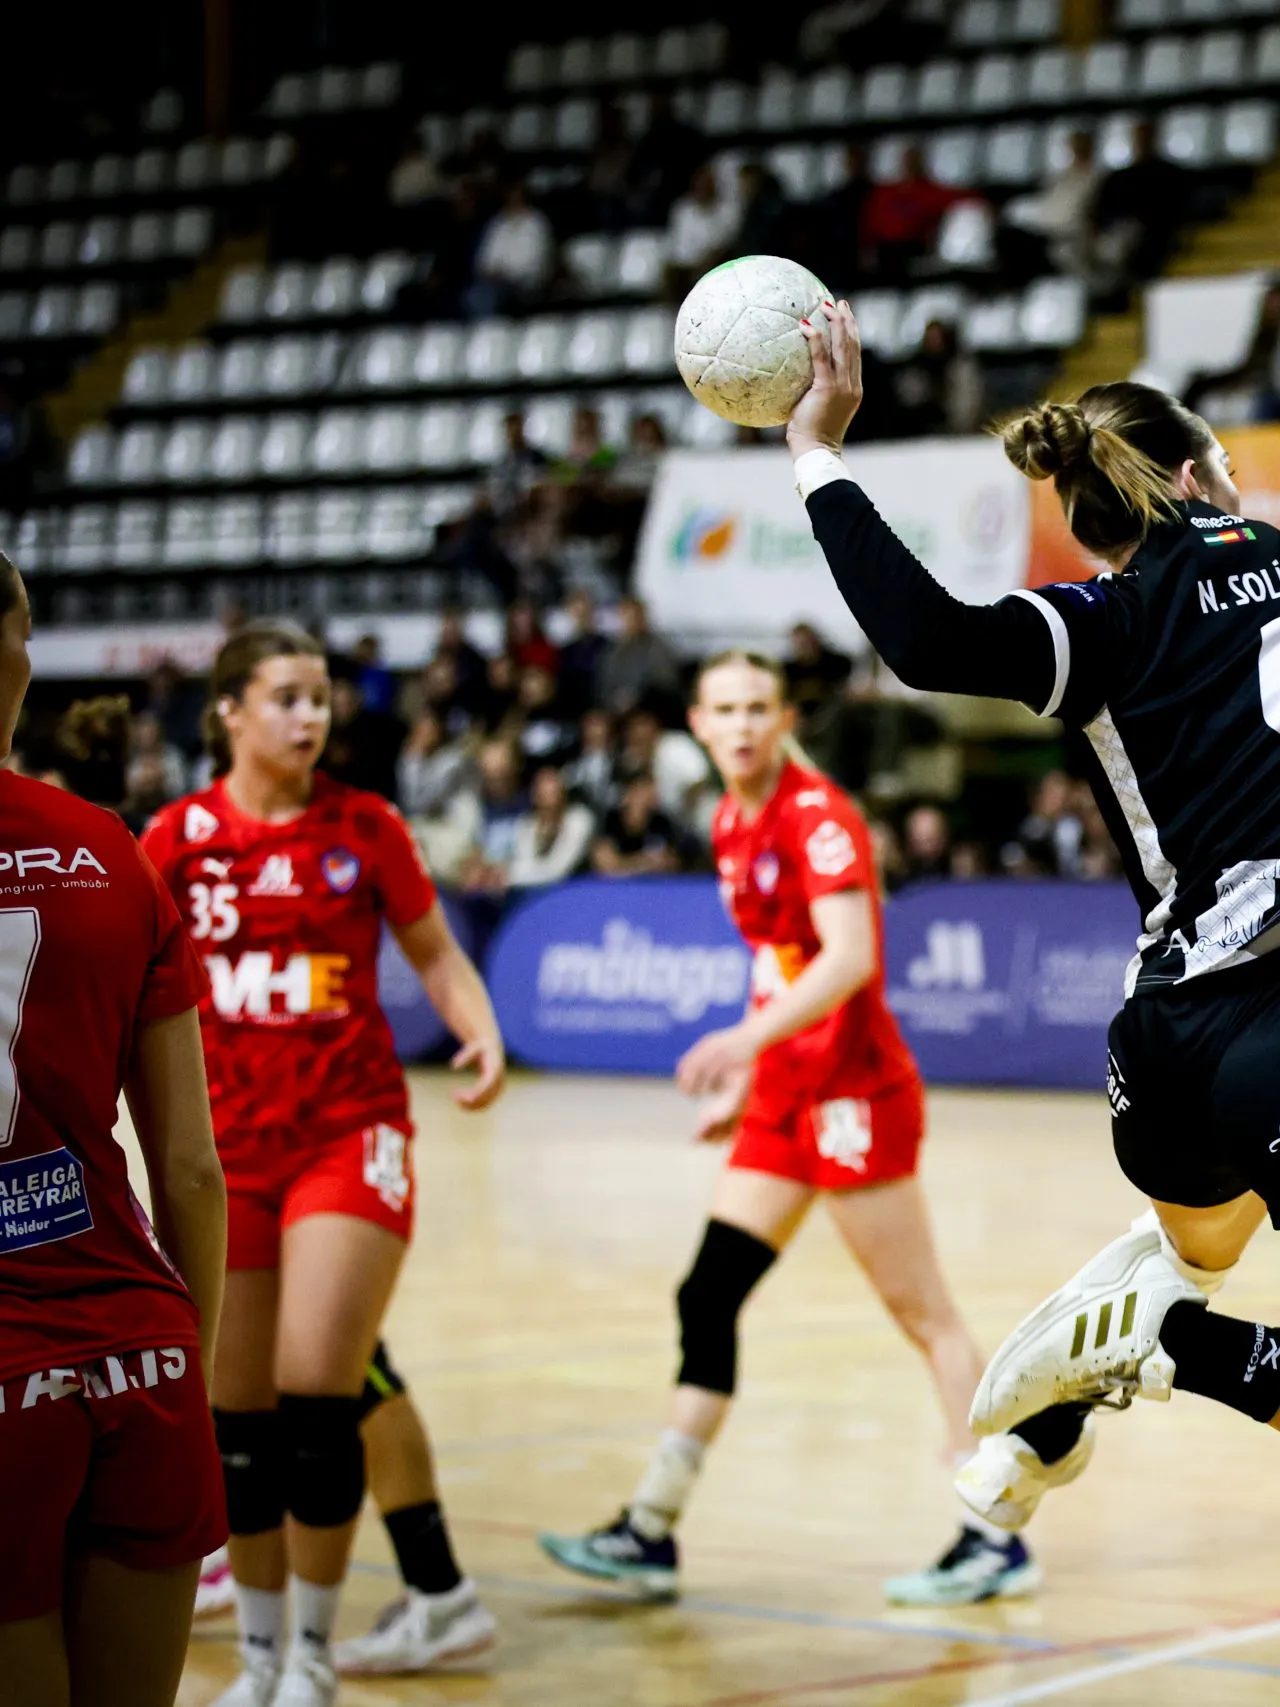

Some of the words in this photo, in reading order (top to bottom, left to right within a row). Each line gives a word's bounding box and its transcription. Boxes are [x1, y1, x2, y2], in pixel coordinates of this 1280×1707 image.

[1198, 579, 1229, 614] N.
[62, 879, 110, 889] umbúðir
[189, 882, 240, 942] 35
[0, 1181, 81, 1217] REYRAR
